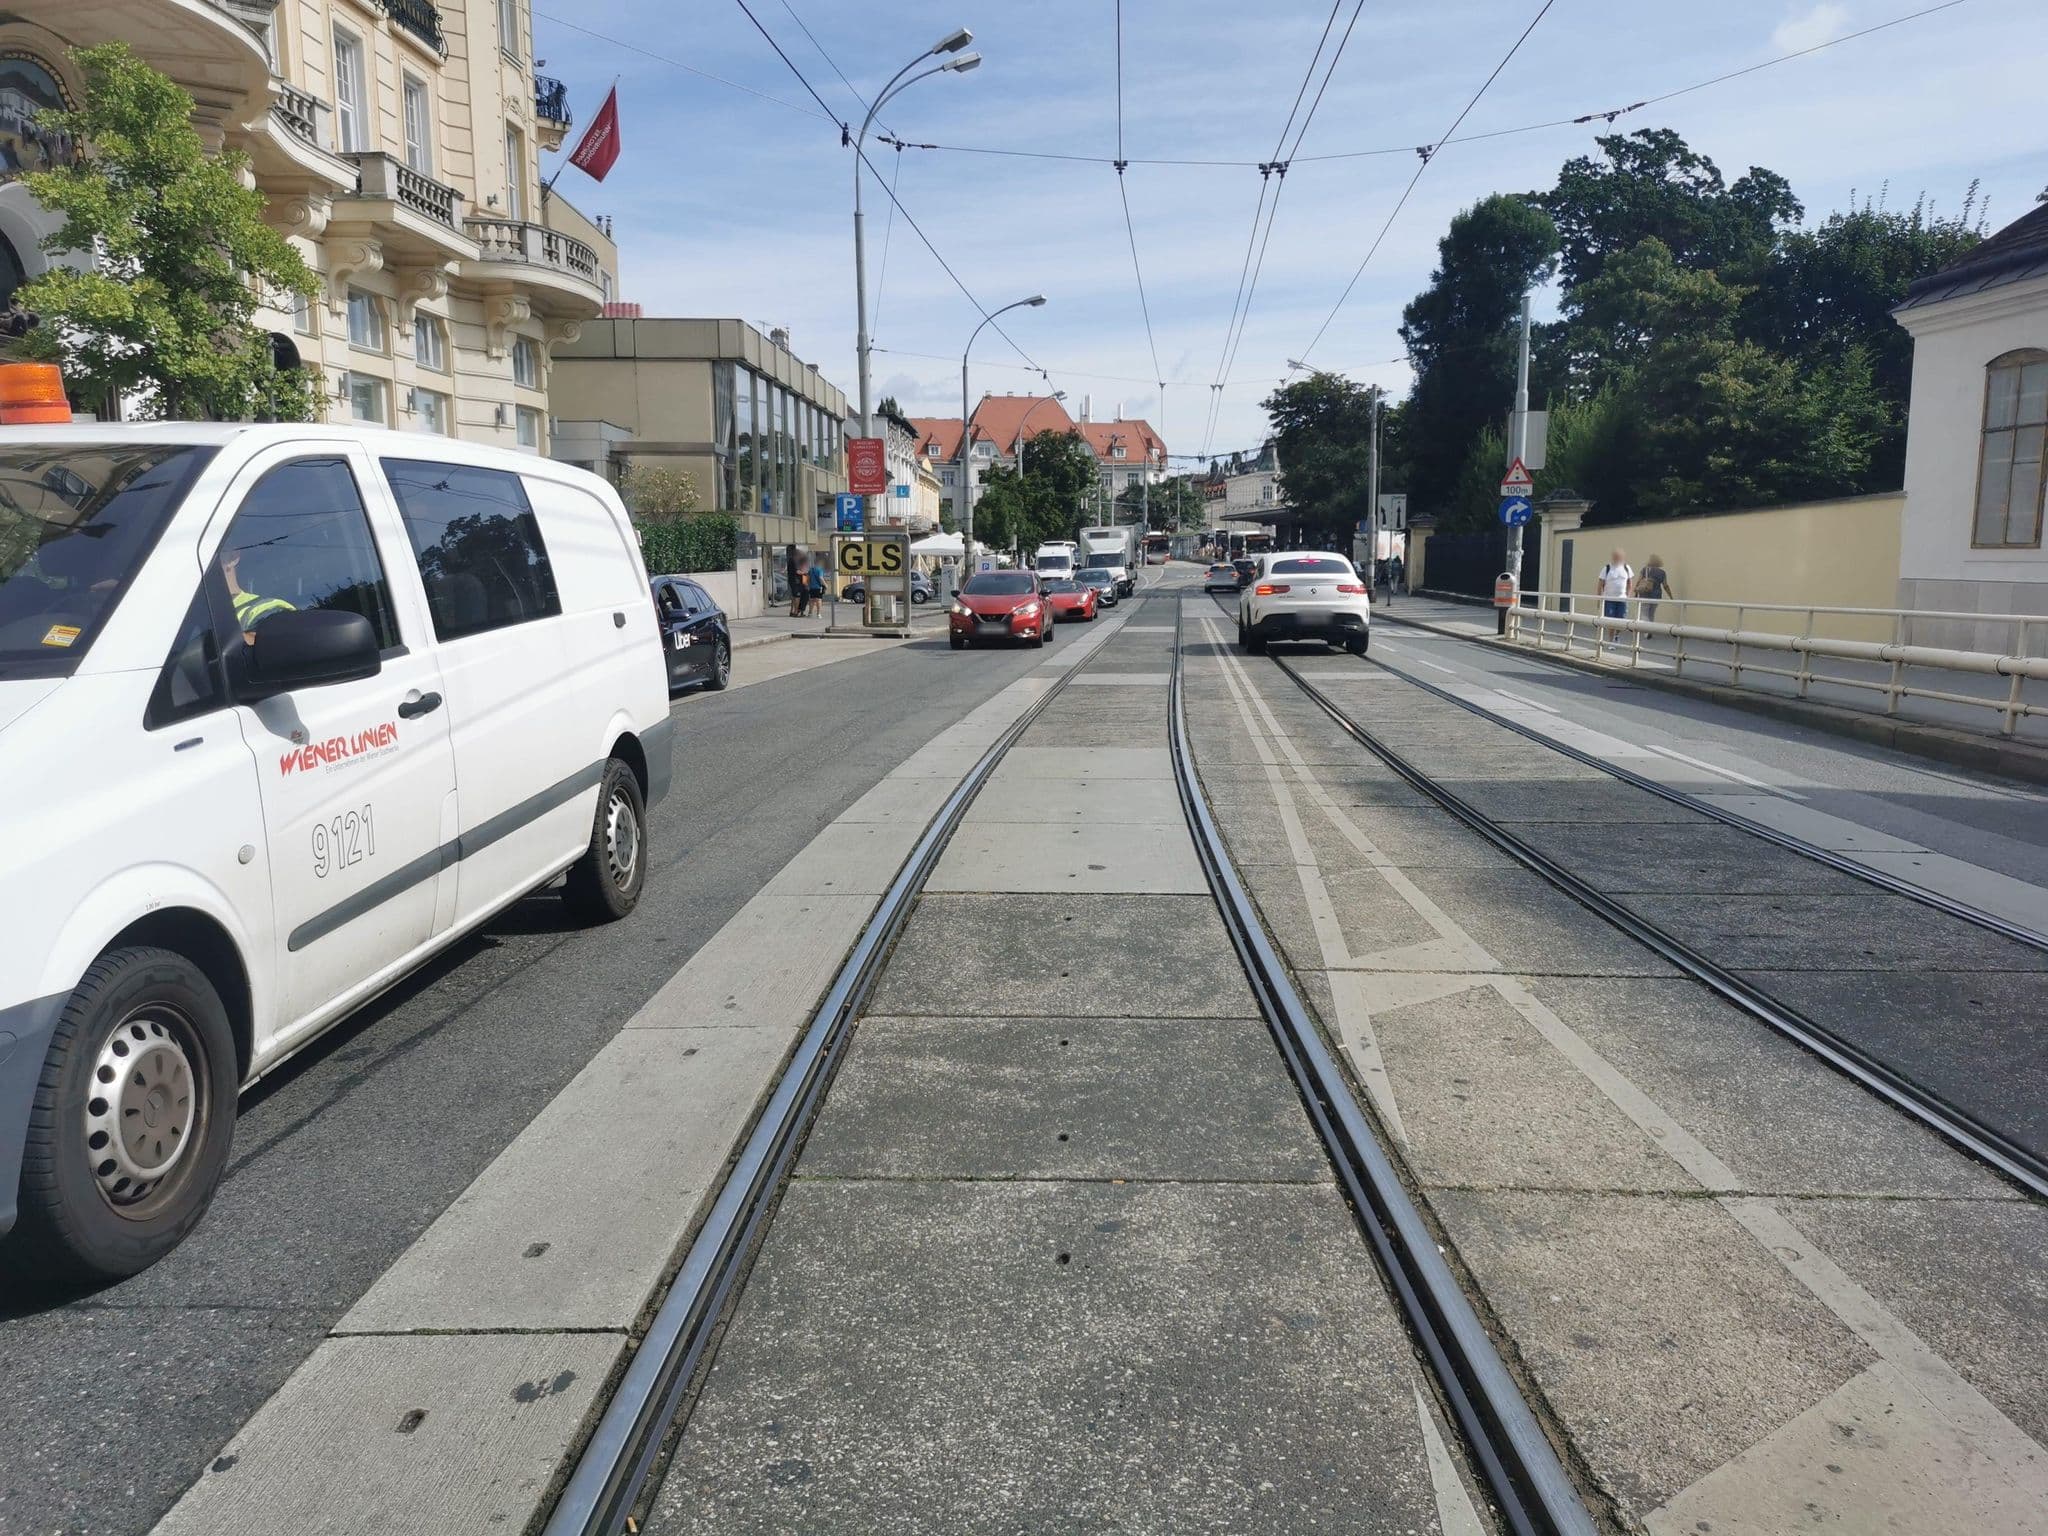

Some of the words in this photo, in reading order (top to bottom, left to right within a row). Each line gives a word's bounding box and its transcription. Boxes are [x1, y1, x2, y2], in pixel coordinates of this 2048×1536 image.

[1506, 486, 1528, 495] 100m
[841, 543, 902, 571] GLS
[674, 631, 691, 650] Uber
[279, 736, 350, 777] WIENER
[350, 721, 398, 756] LINIEN
[312, 804, 374, 878] 9121
